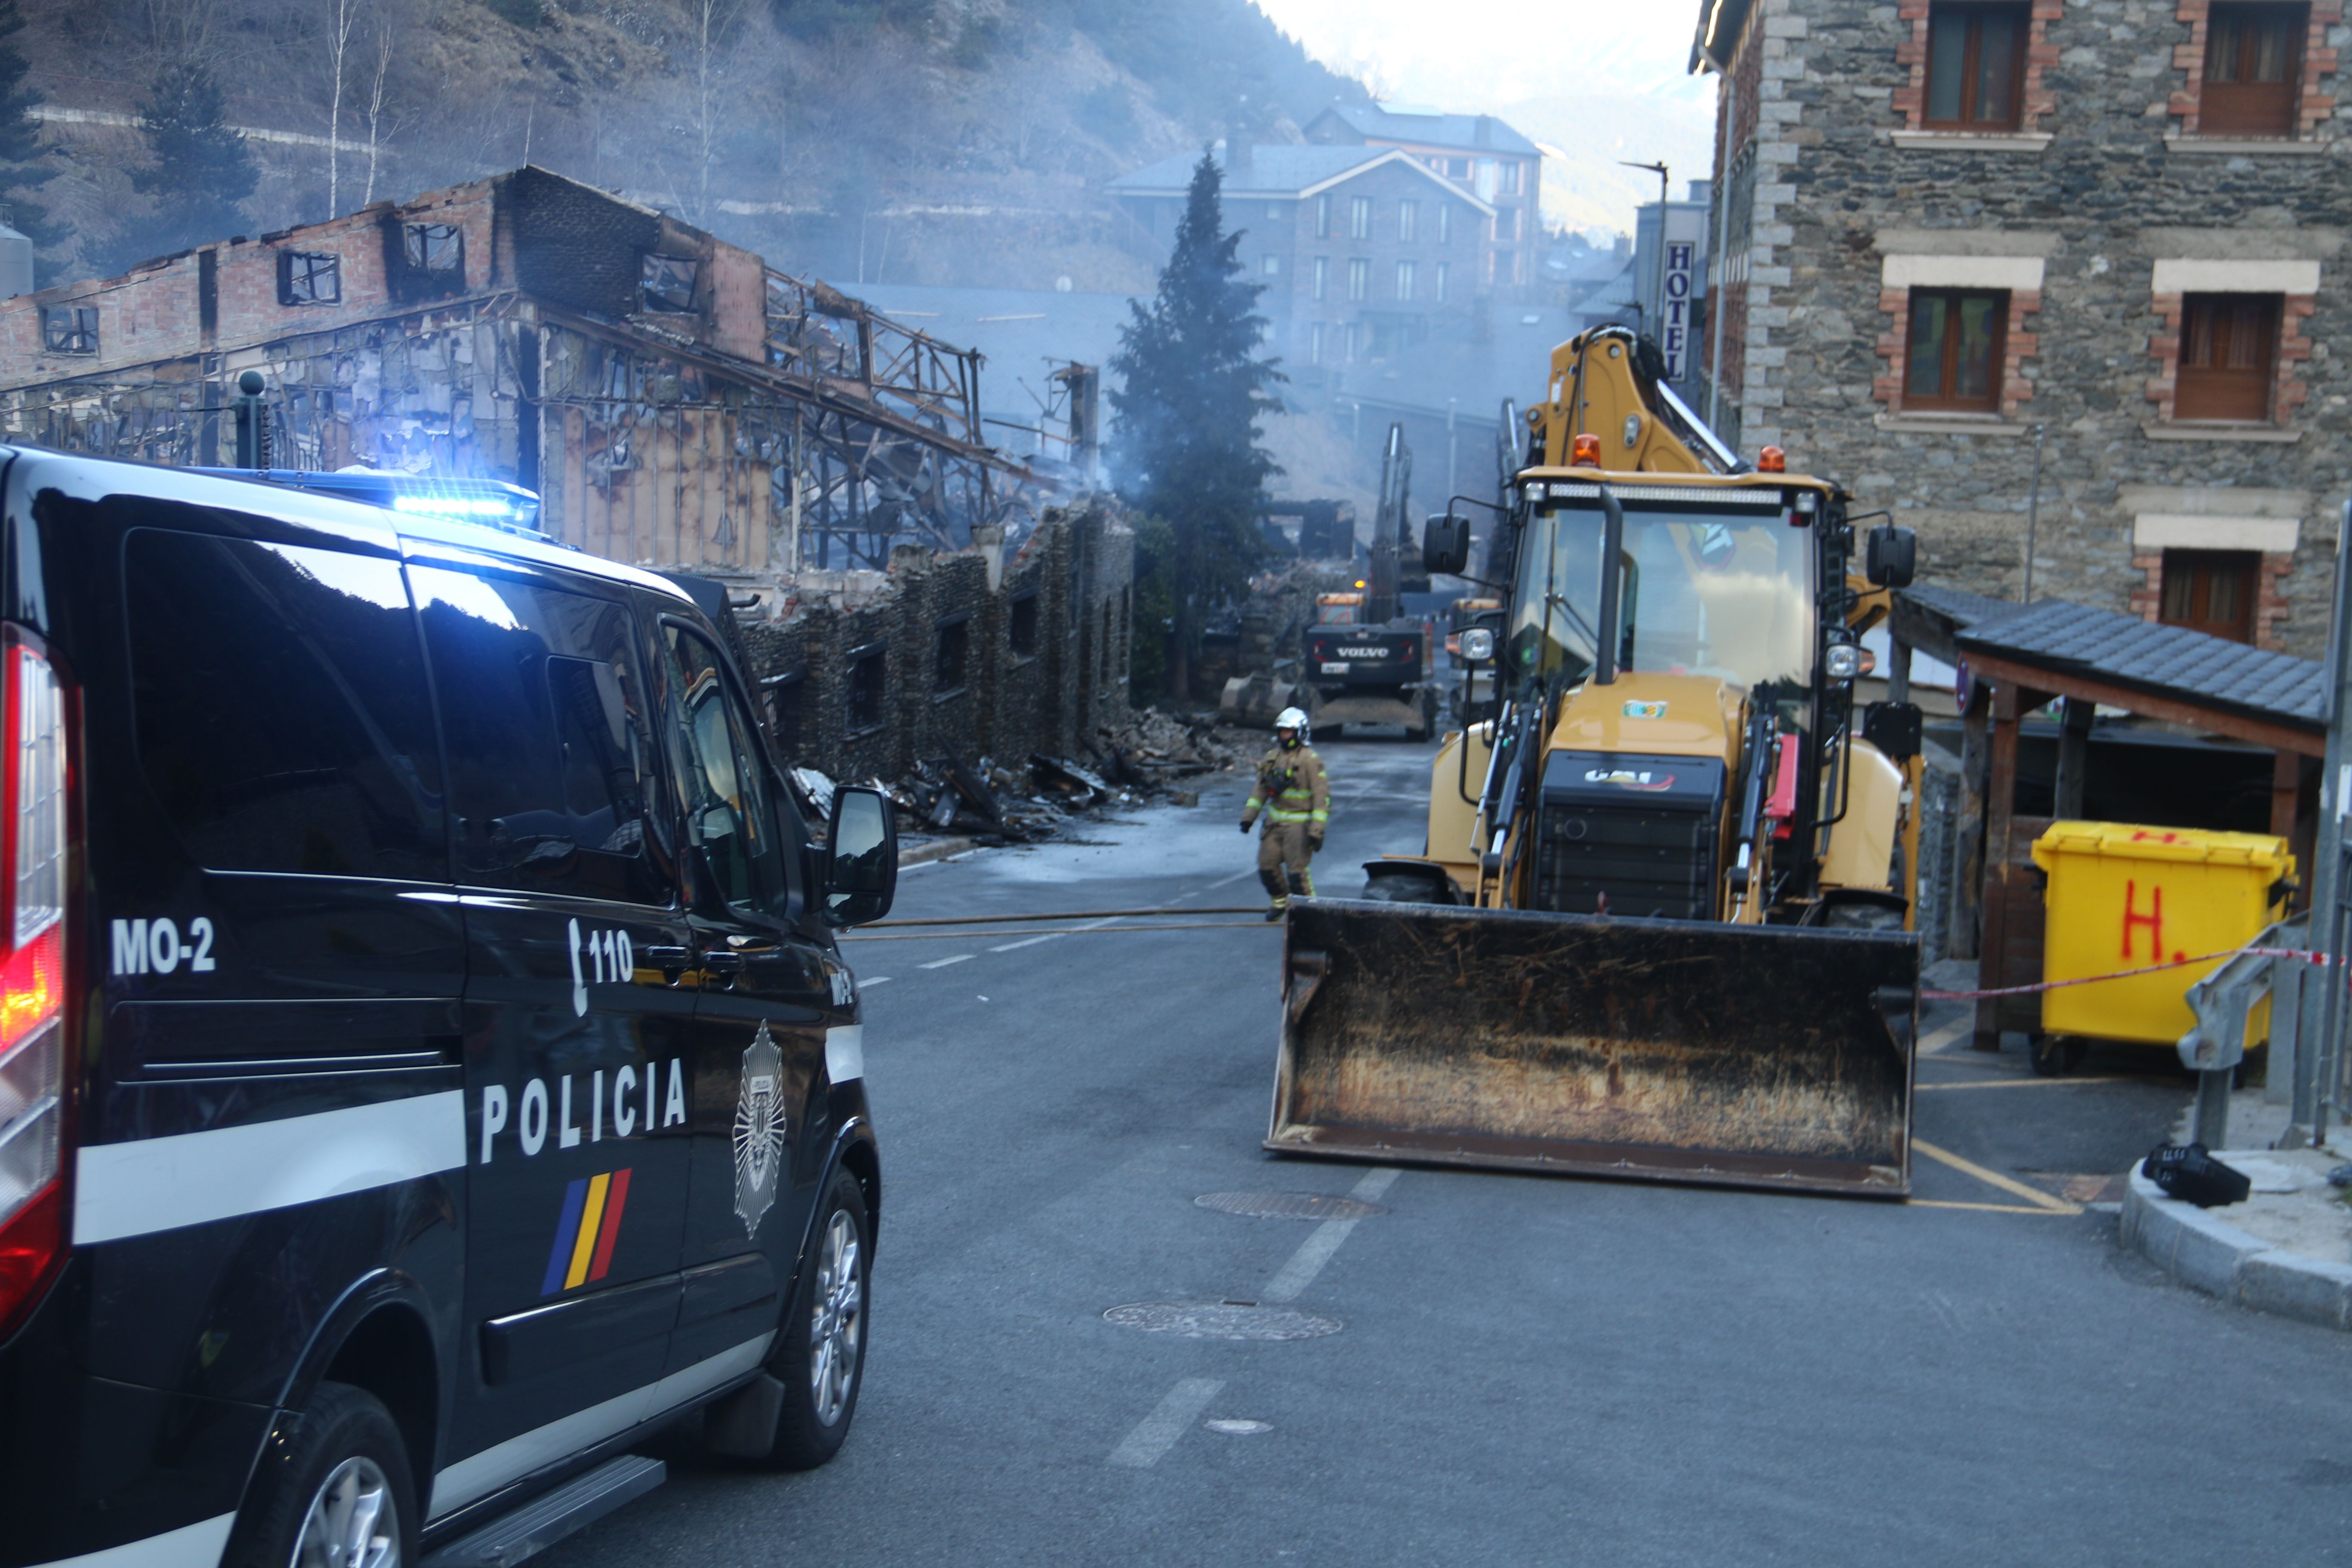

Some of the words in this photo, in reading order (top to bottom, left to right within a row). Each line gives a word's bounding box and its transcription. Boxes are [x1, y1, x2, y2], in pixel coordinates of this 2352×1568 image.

[1666, 246, 1690, 378] HOTEL
[1336, 647, 1390, 658] VOLVO
[112, 916, 215, 975] MO-2
[589, 929, 634, 983] 110
[481, 1057, 686, 1164] POLICIA
